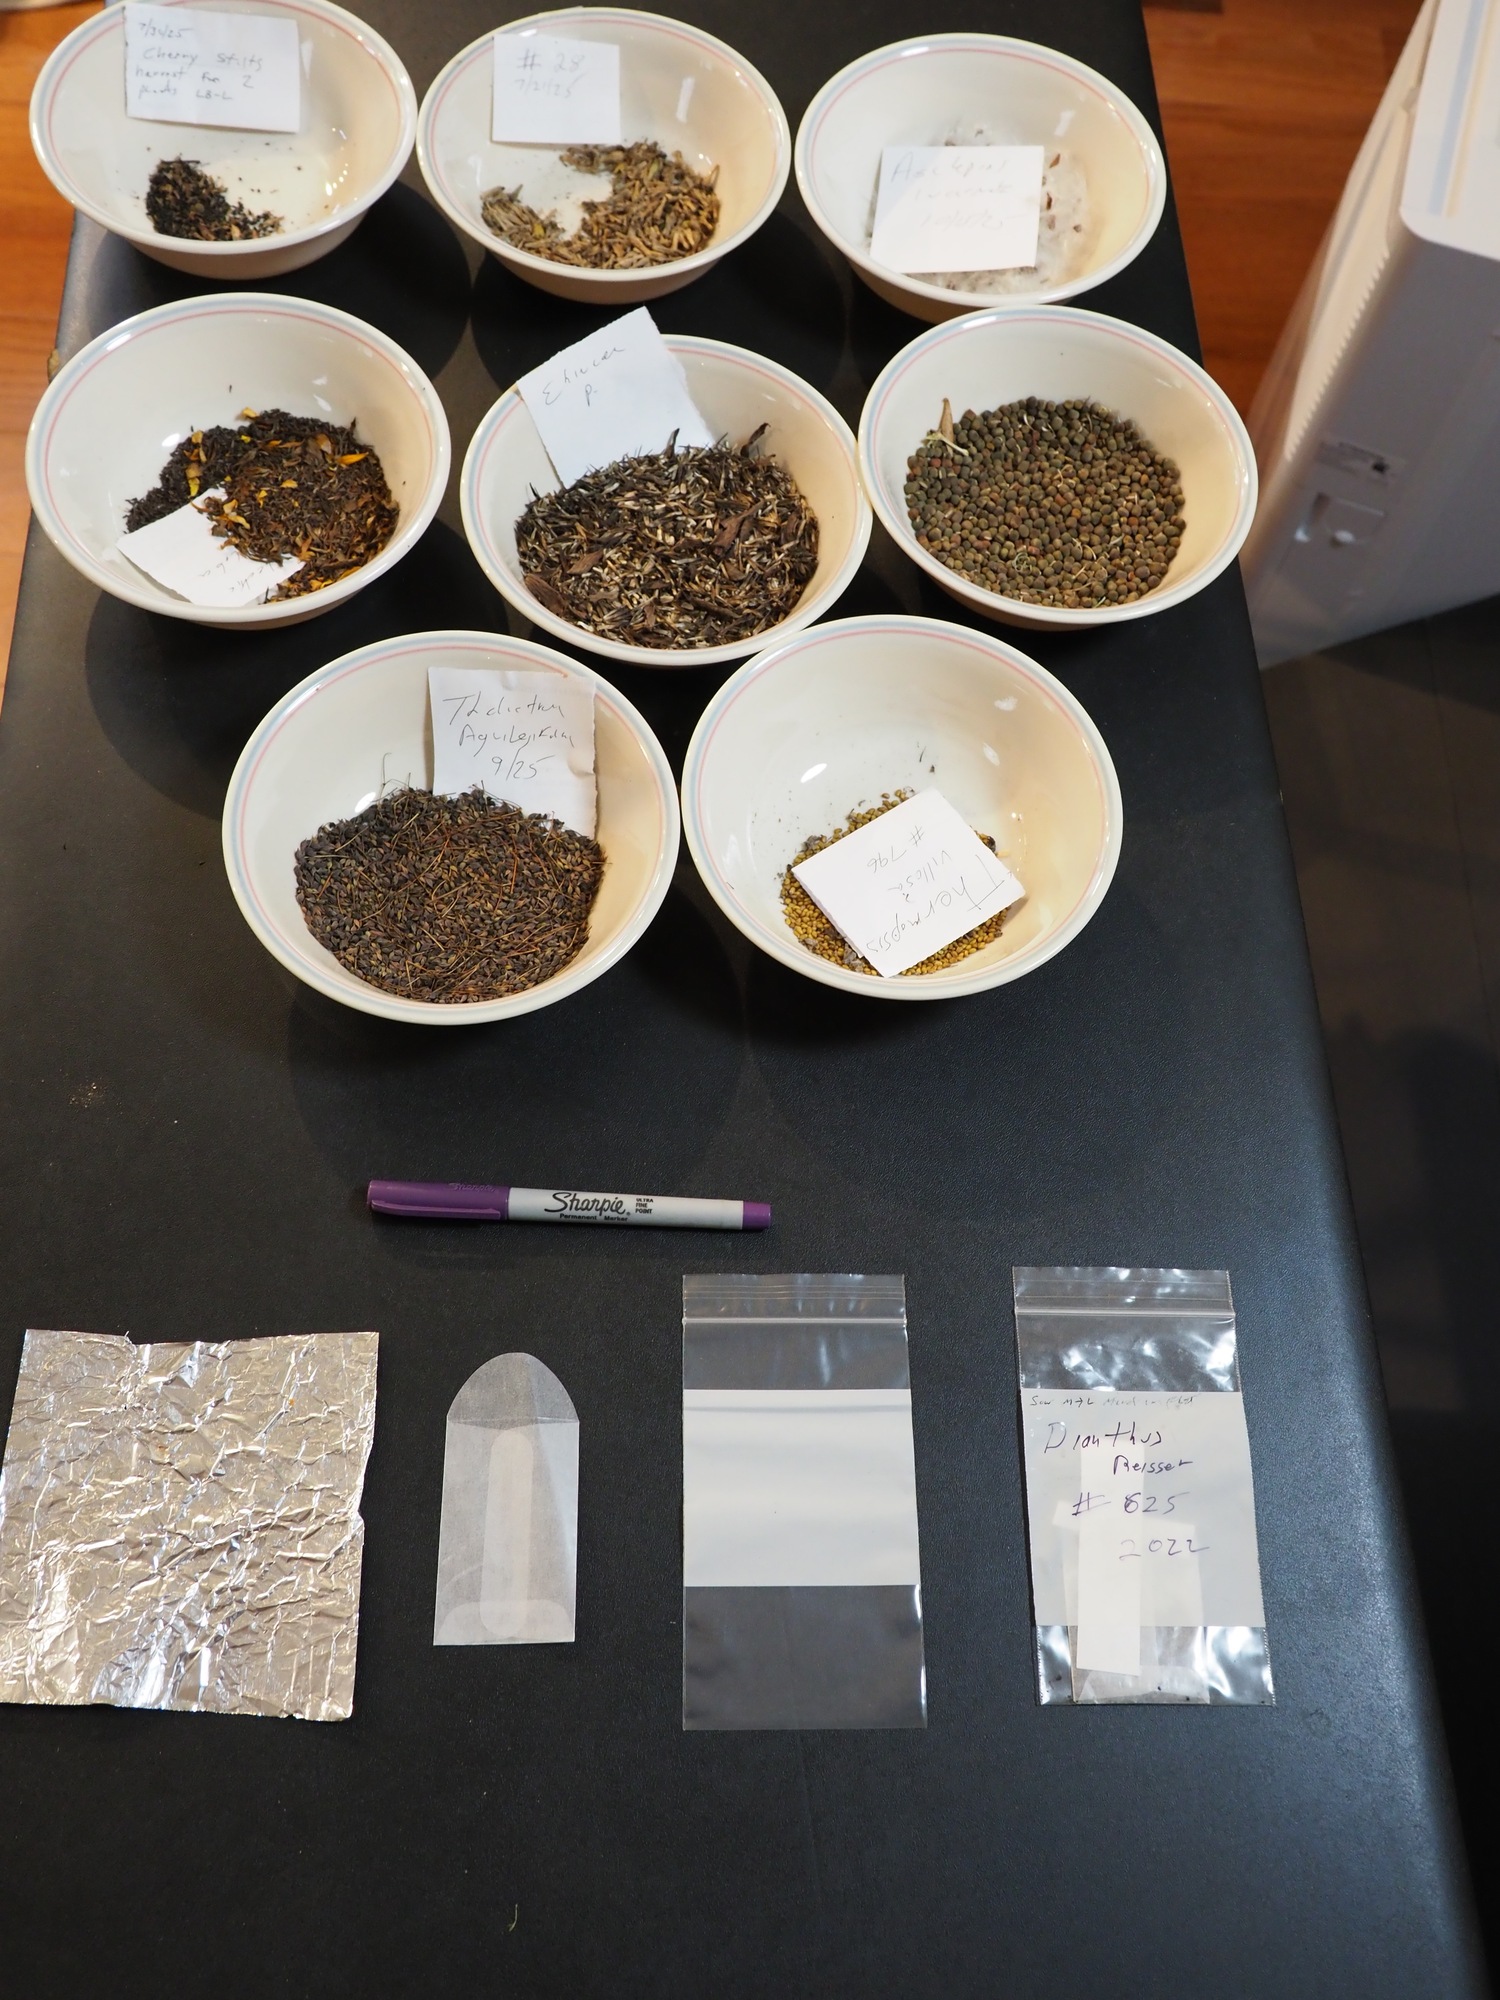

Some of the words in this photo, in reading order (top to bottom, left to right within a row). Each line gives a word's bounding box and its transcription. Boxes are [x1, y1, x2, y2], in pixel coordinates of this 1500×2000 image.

[543, 1191, 626, 1216] Sharpie
[559, 1212, 598, 1221] Permanent
[1043, 1420, 1163, 1454] Dianthus
[1071, 1491, 1112, 1516] #
[1118, 1538, 1211, 1562] 2022
